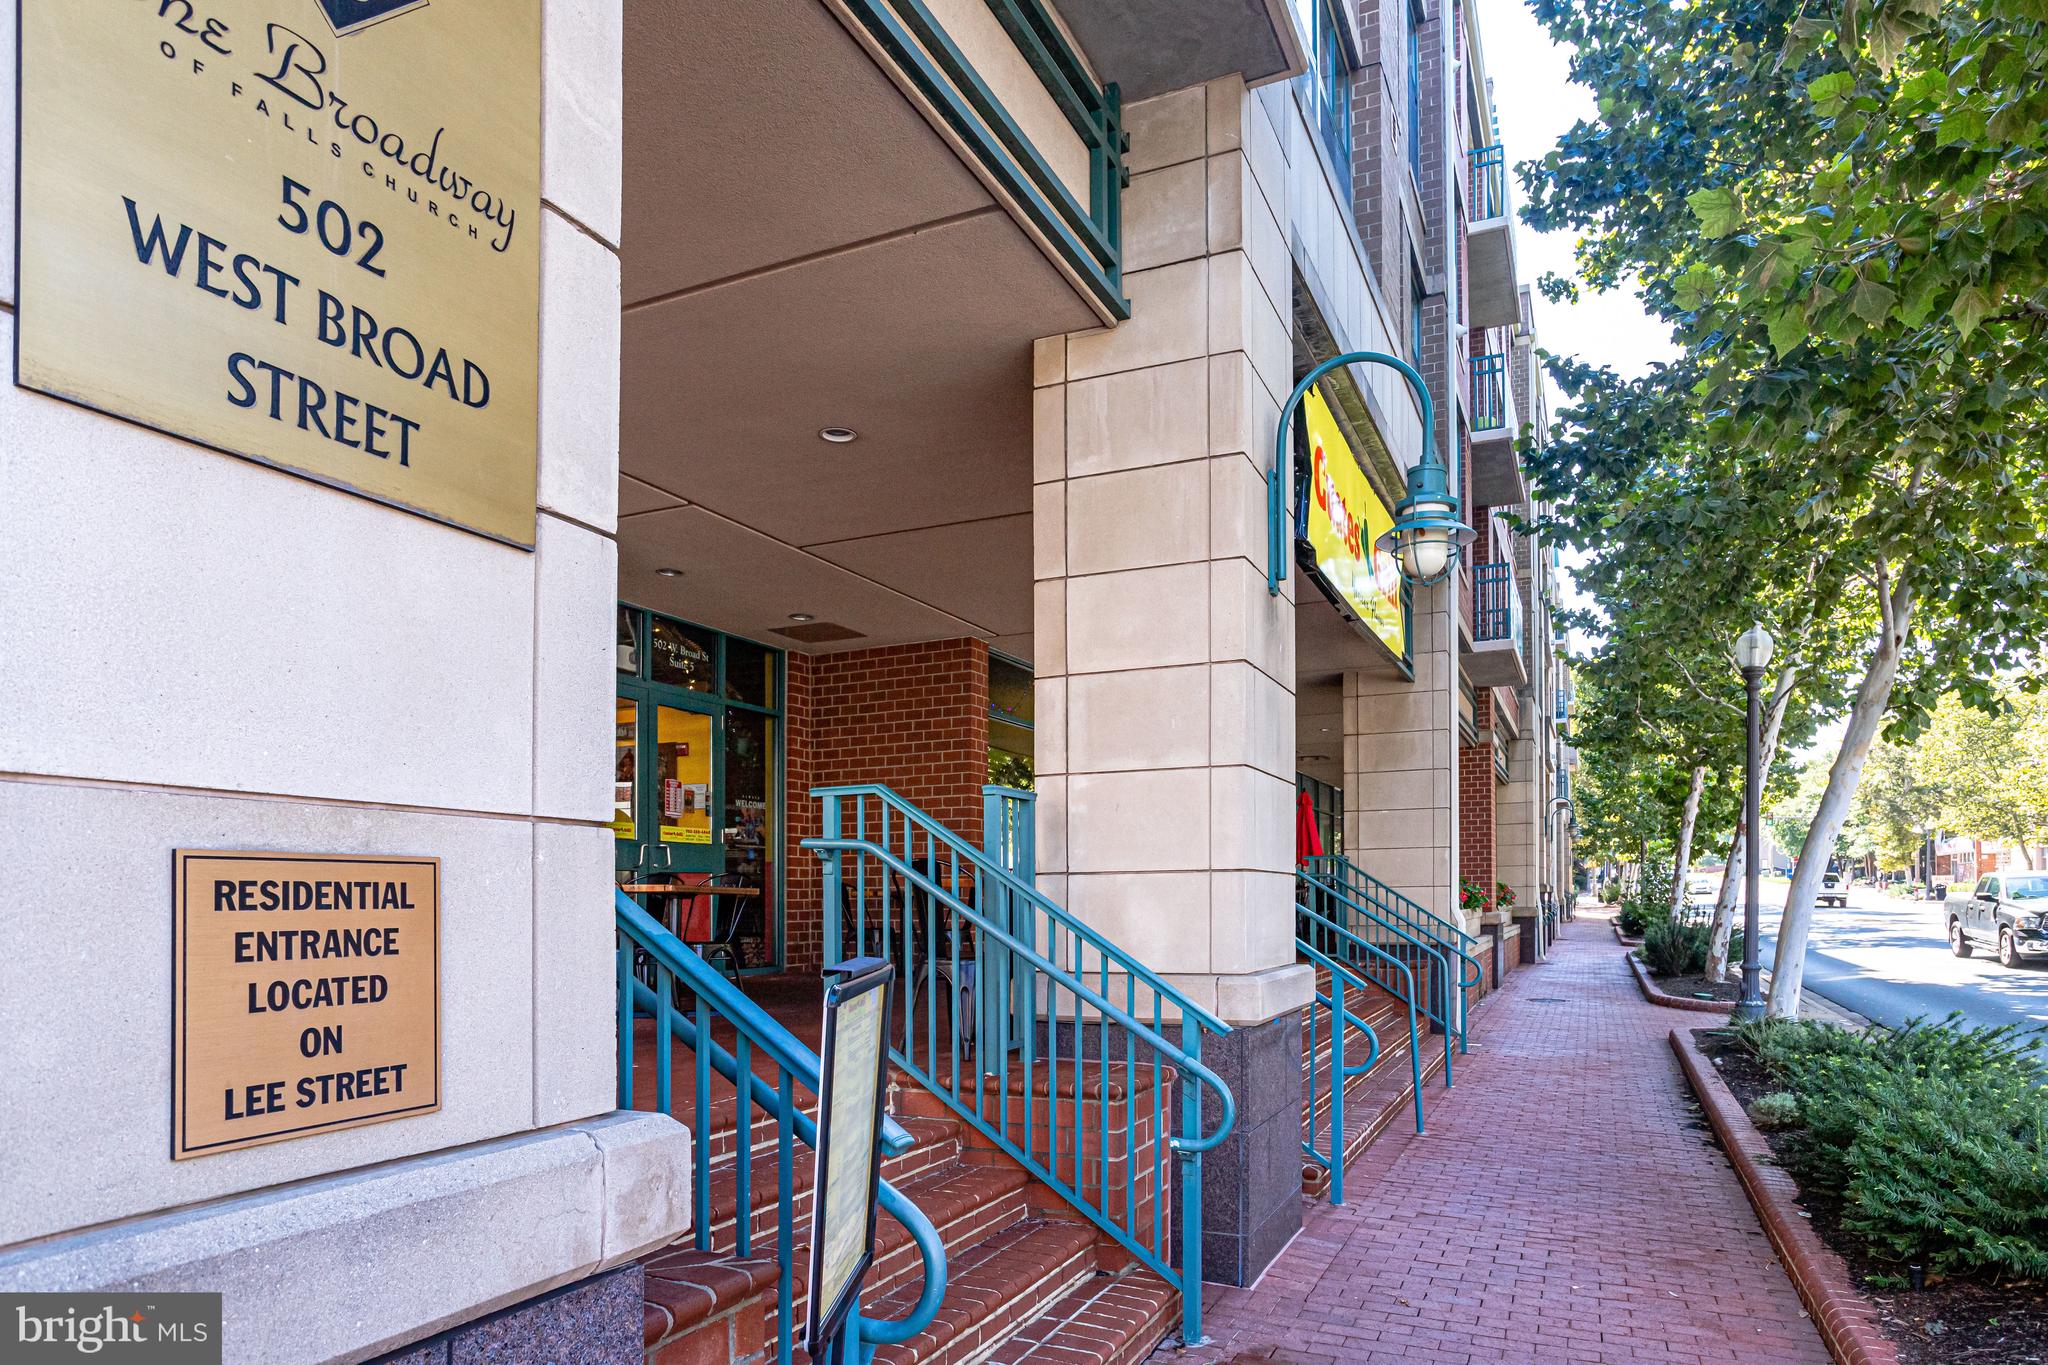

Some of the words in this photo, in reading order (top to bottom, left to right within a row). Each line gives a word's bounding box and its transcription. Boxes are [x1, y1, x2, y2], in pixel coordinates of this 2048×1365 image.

[157, 0, 233, 55] he
[254, 22, 516, 253] Broadway
[160, 41, 205, 75] OF
[231, 82, 343, 159] FALLS
[361, 161, 479, 240] CHURCH
[277, 174, 388, 278] 502
[121, 194, 301, 326] WEST
[318, 289, 491, 410] BROAD
[226, 351, 421, 469] STREET
[653, 638, 667, 651] 502
[680, 645, 701, 660] Broad
[701, 650, 710, 662] St
[669, 655, 688, 670] Suite
[689, 661, 695, 672] 5
[735, 799, 766, 810] WELCOME
[213, 880, 415, 912] RESIDENTIAL
[234, 927, 400, 963] ENTRANCE
[248, 974, 389, 1014] LOCATED
[299, 1025, 344, 1059] ON
[224, 1080, 287, 1121] LEE
[295, 1063, 408, 1109] STREET
